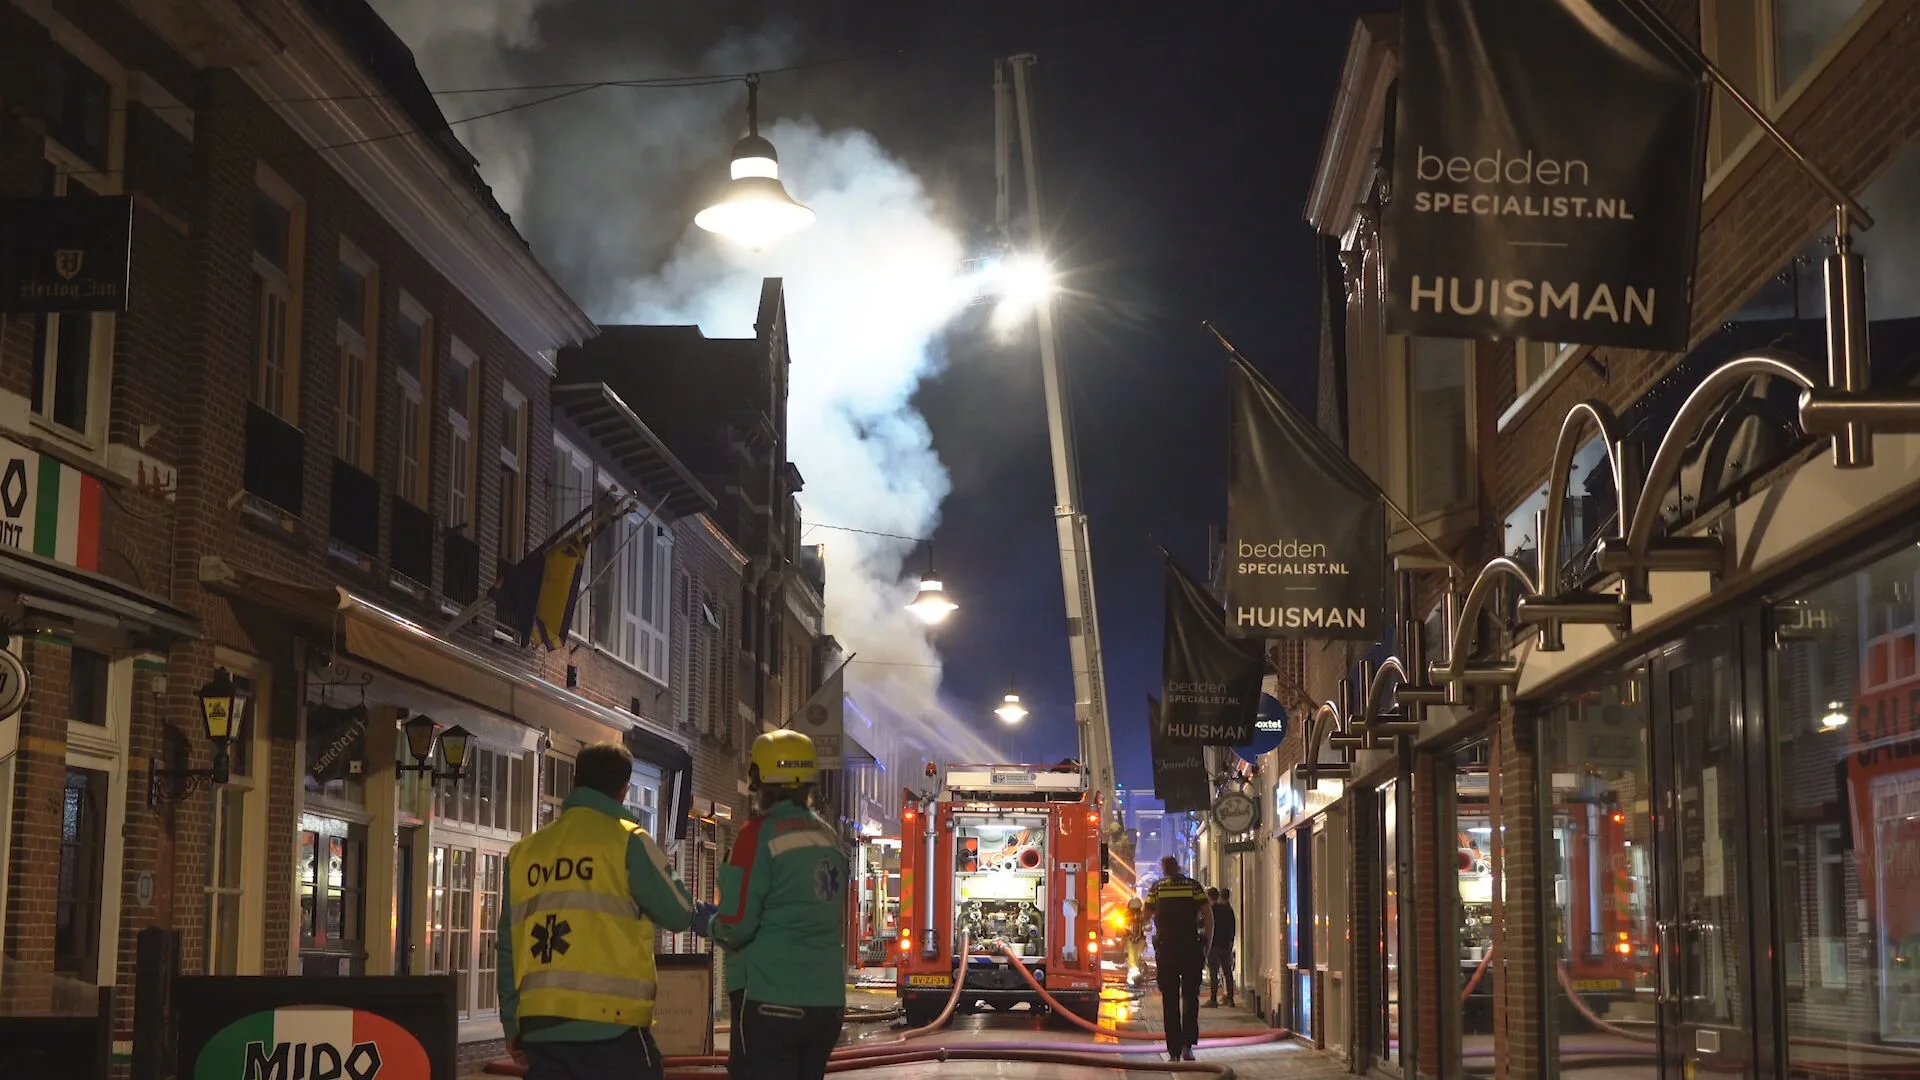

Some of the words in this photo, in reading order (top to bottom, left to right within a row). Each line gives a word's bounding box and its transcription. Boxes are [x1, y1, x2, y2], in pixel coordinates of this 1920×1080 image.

[1416, 145, 1590, 187] bedden
[1414, 191, 1635, 220] SPECIALIST.NL
[1408, 275, 1657, 327] HUISMAN
[1237, 538, 1327, 558] bedden
[1237, 563, 1350, 576] SPECIALIST.NL
[1236, 606, 1368, 630] HUISMAN
[1168, 678, 1227, 694] bedden
[1168, 695, 1241, 706] SPECIALIST.NL
[1167, 722, 1248, 740] HUISMAN
[528, 856, 594, 887] OvDG
